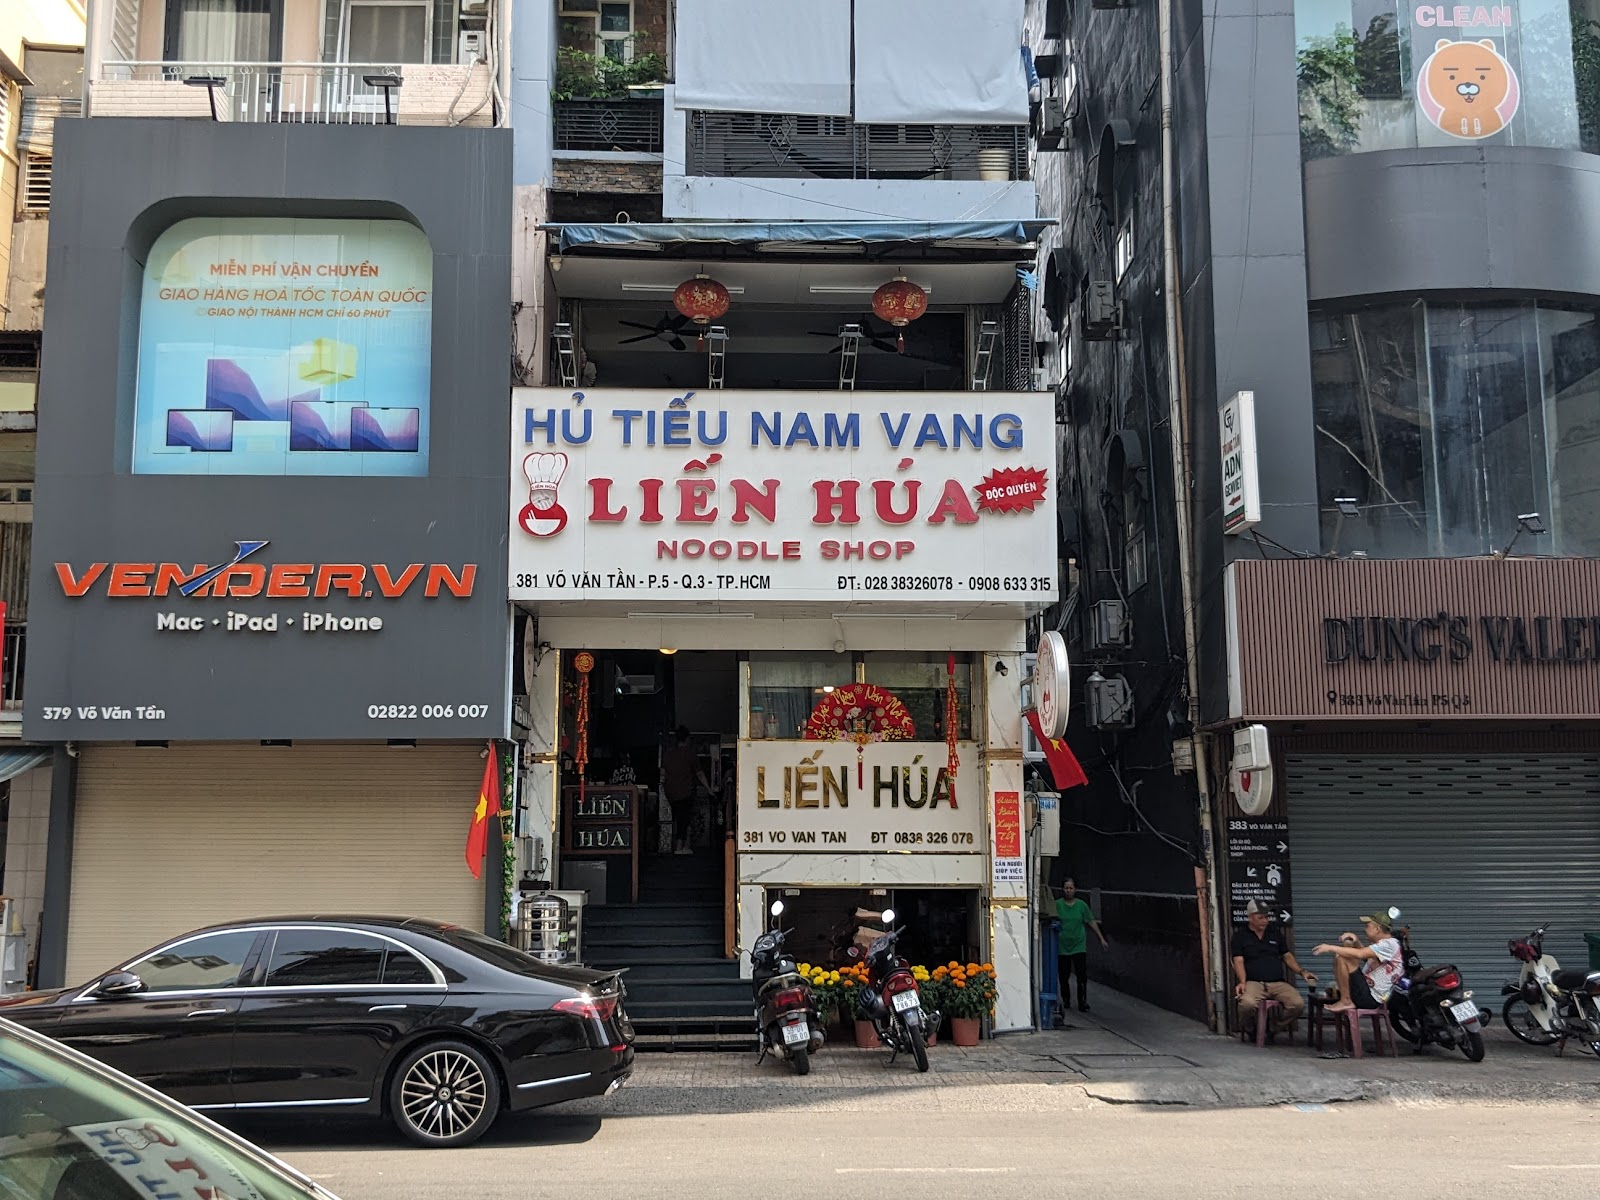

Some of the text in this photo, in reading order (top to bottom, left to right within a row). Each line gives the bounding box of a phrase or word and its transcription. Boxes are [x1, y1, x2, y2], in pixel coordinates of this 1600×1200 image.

[1416, 6, 1512, 27] CLEAN
[252, 261, 276, 276] PHÍ
[282, 261, 312, 280] VẬN
[160, 288, 199, 302] GIAO
[204, 286, 250, 301] HÀNG
[294, 286, 326, 302] TỐC
[332, 288, 373, 302] TOÀN
[378, 286, 427, 303] QUỐC
[208, 308, 236, 317] GIAO
[238, 306, 258, 318] NỘI
[299, 308, 323, 318] HCM
[347, 309, 360, 318] 60
[525, 391, 1024, 450] HỦ TIẾU NAM VANG
[1224, 450, 1241, 481] ADN
[587, 453, 980, 526] LIẾN HÚA
[986, 486, 1005, 502] ĐỘC
[656, 539, 916, 560] NOODLE SHOP
[54, 560, 478, 598] VENDER.VN
[516, 574, 538, 588] 381
[546, 570, 566, 588] VÕ
[572, 571, 600, 588] VĂN
[607, 568, 635, 588] TẦN
[838, 576, 1050, 590] ĐT: 028 38326078 0908 633 315
[156, 612, 384, 632] Mac iPad iPhone
[43, 703, 166, 720] 379 Võ Văn Tần
[368, 704, 488, 718] 02822 006 007
[758, 750, 849, 809] LIẾN
[873, 755, 958, 810] HÚA
[1229, 820, 1248, 830] 383
[579, 828, 625, 847] HÚA
[744, 831, 764, 843] 381
[769, 831, 786, 843] VO
[791, 831, 815, 843] VAN
[822, 831, 847, 843] TAN
[871, 832, 888, 844] ĐT
[927, 832, 948, 844] 326
[951, 832, 974, 844] 078
